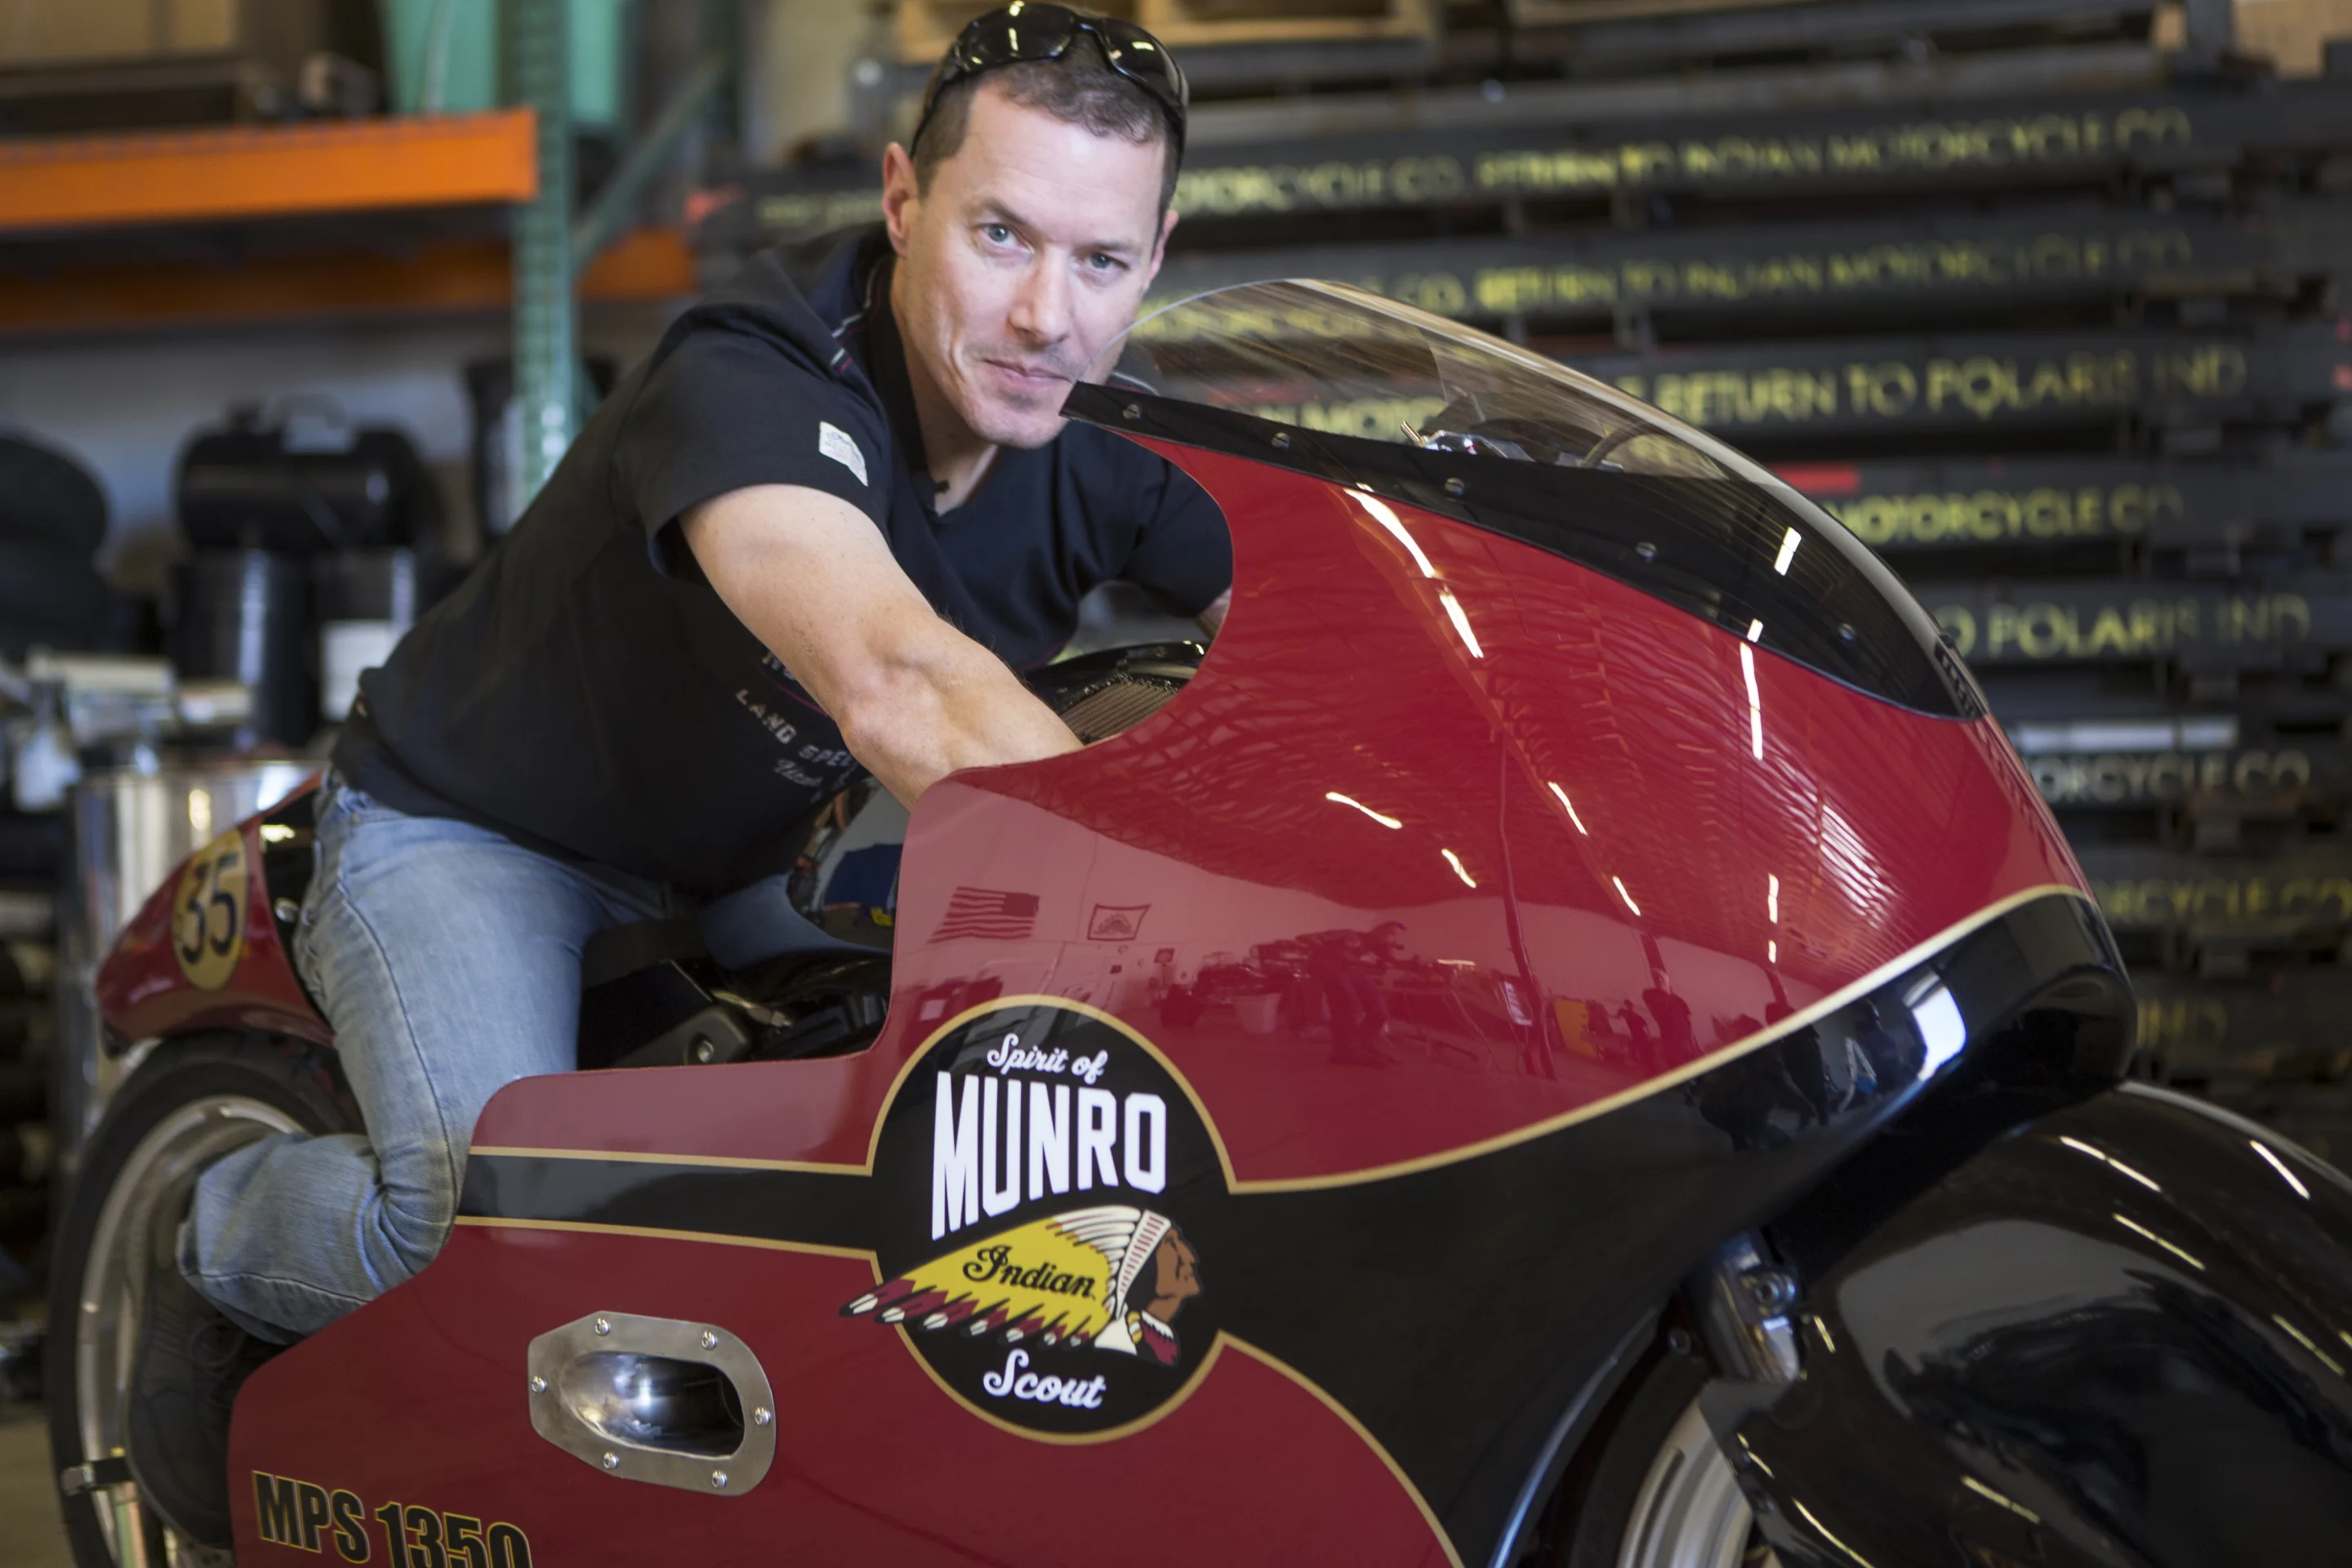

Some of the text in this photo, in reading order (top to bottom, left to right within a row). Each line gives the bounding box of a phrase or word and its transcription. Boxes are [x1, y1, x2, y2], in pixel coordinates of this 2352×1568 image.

[1655, 364, 1838, 426] RETURN
[1844, 359, 1919, 418] TO
[736, 688, 797, 745] LAND
[180, 849, 240, 965] 35
[987, 1032, 1109, 1085] Spirit of
[931, 1070, 1168, 1241] MUNRO
[962, 1245, 1096, 1300] Indian
[982, 1348, 1107, 1410] Scout
[251, 1469, 534, 1568] MPS 1350
